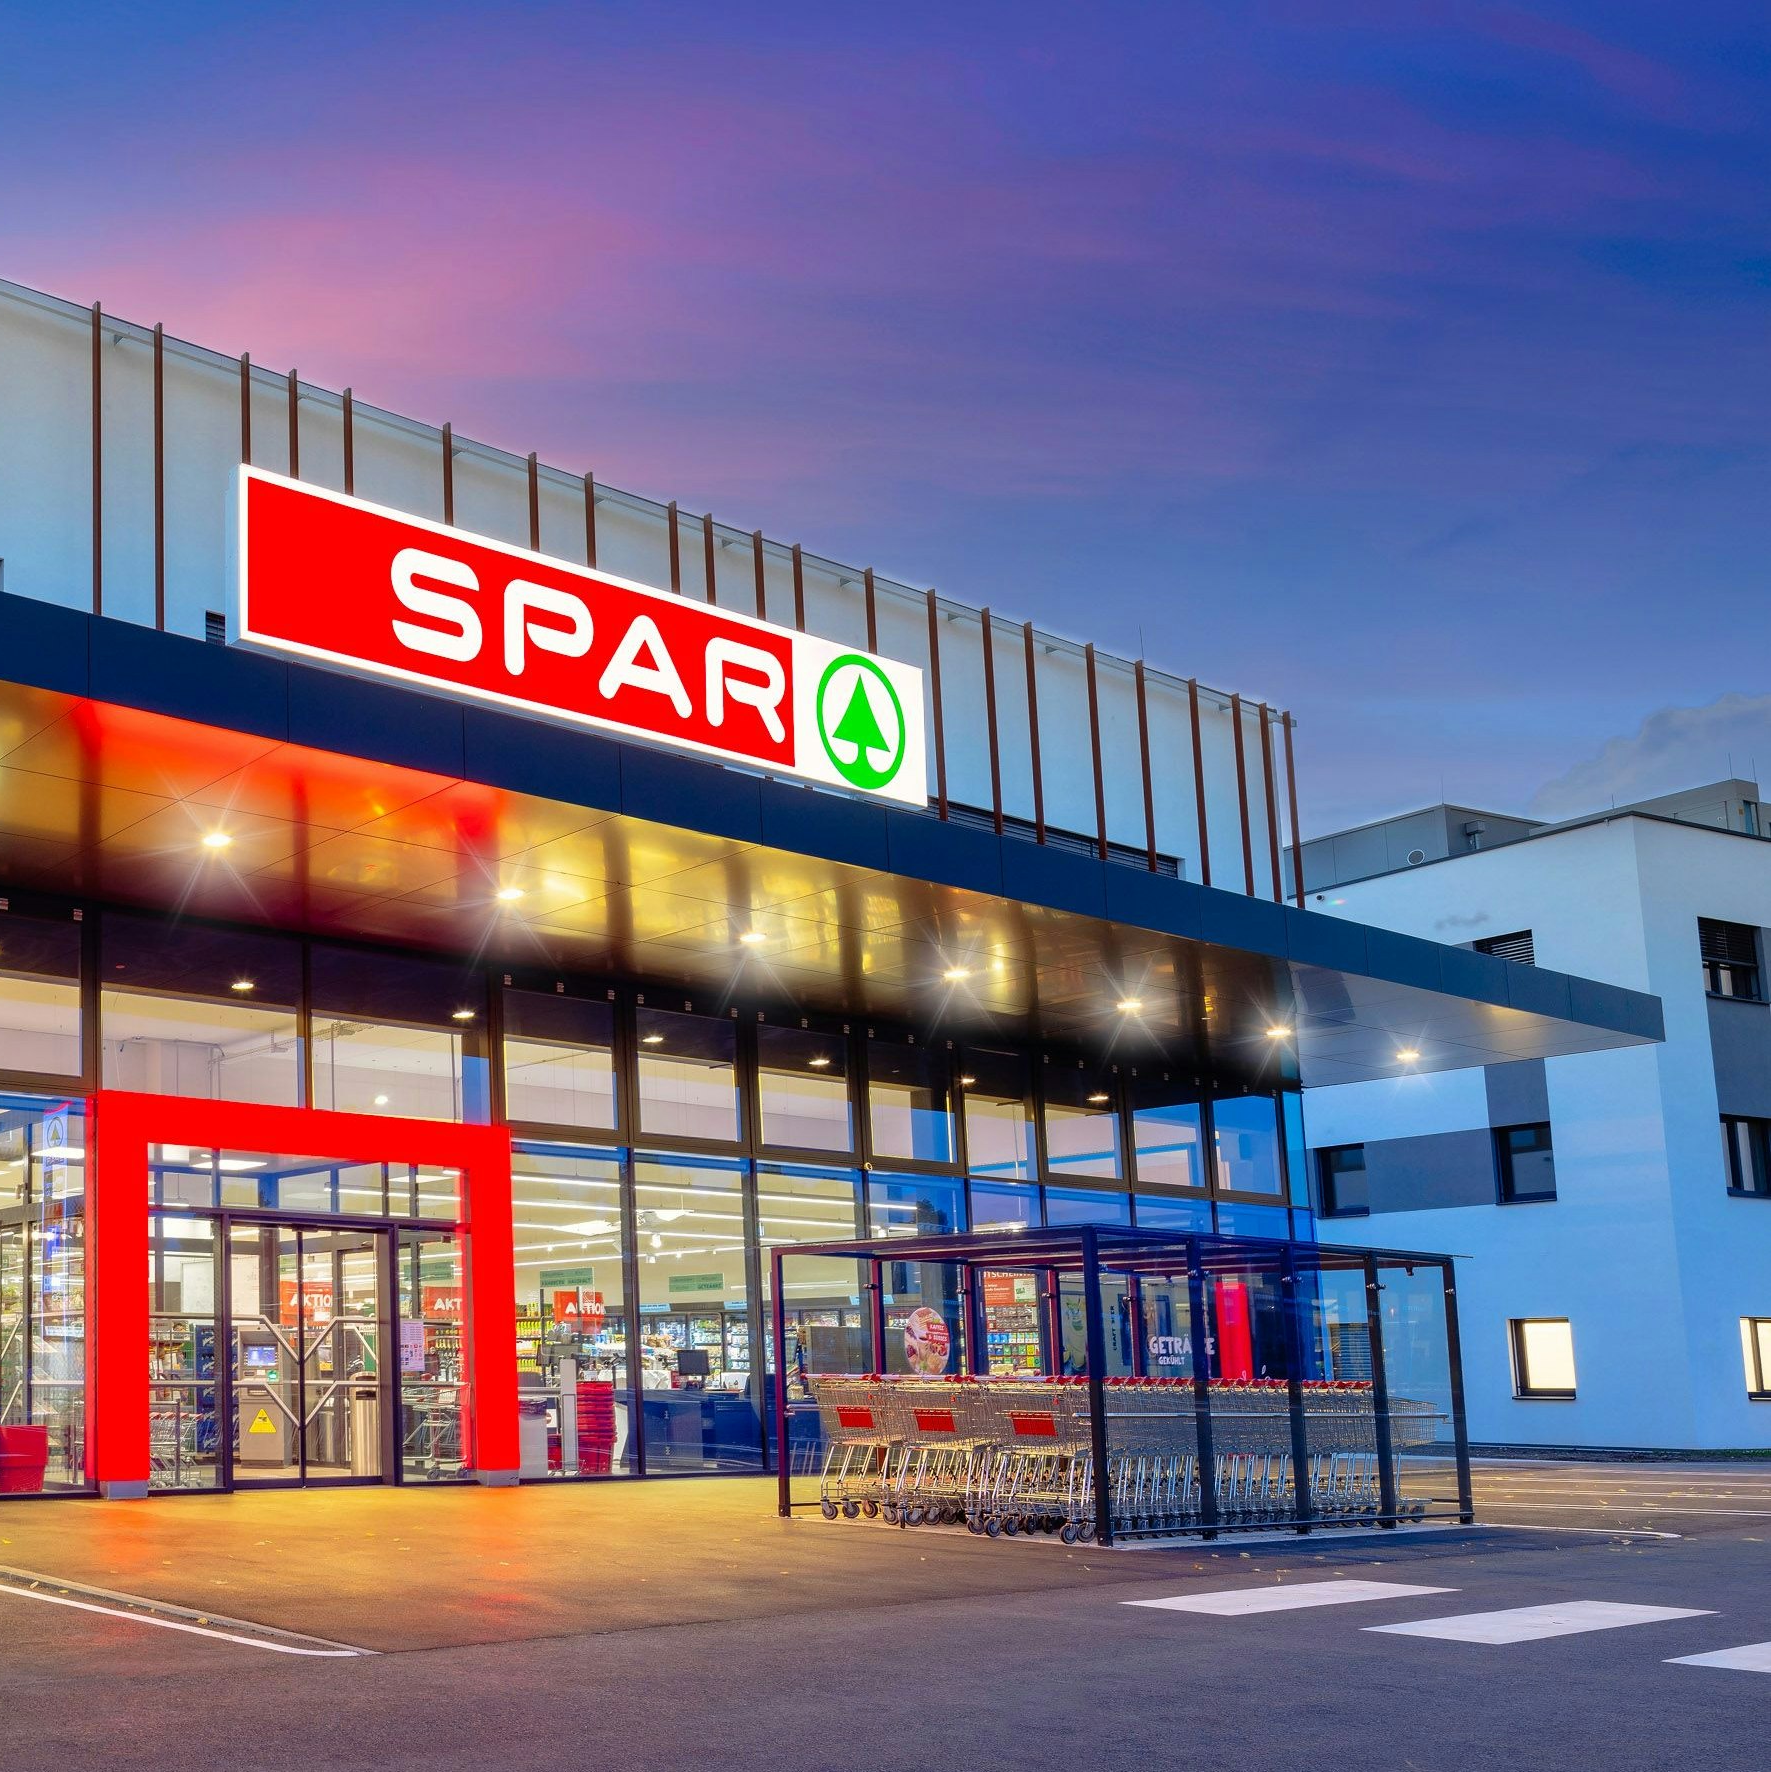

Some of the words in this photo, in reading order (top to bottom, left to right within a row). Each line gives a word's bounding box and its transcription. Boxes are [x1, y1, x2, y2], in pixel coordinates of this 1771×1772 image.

[391, 547, 786, 744] SPAR
[289, 1293, 333, 1307] AKTIO
[1149, 1333, 1216, 1355] GETRÄE
[1158, 1355, 1185, 1365] GEKÜHLT
